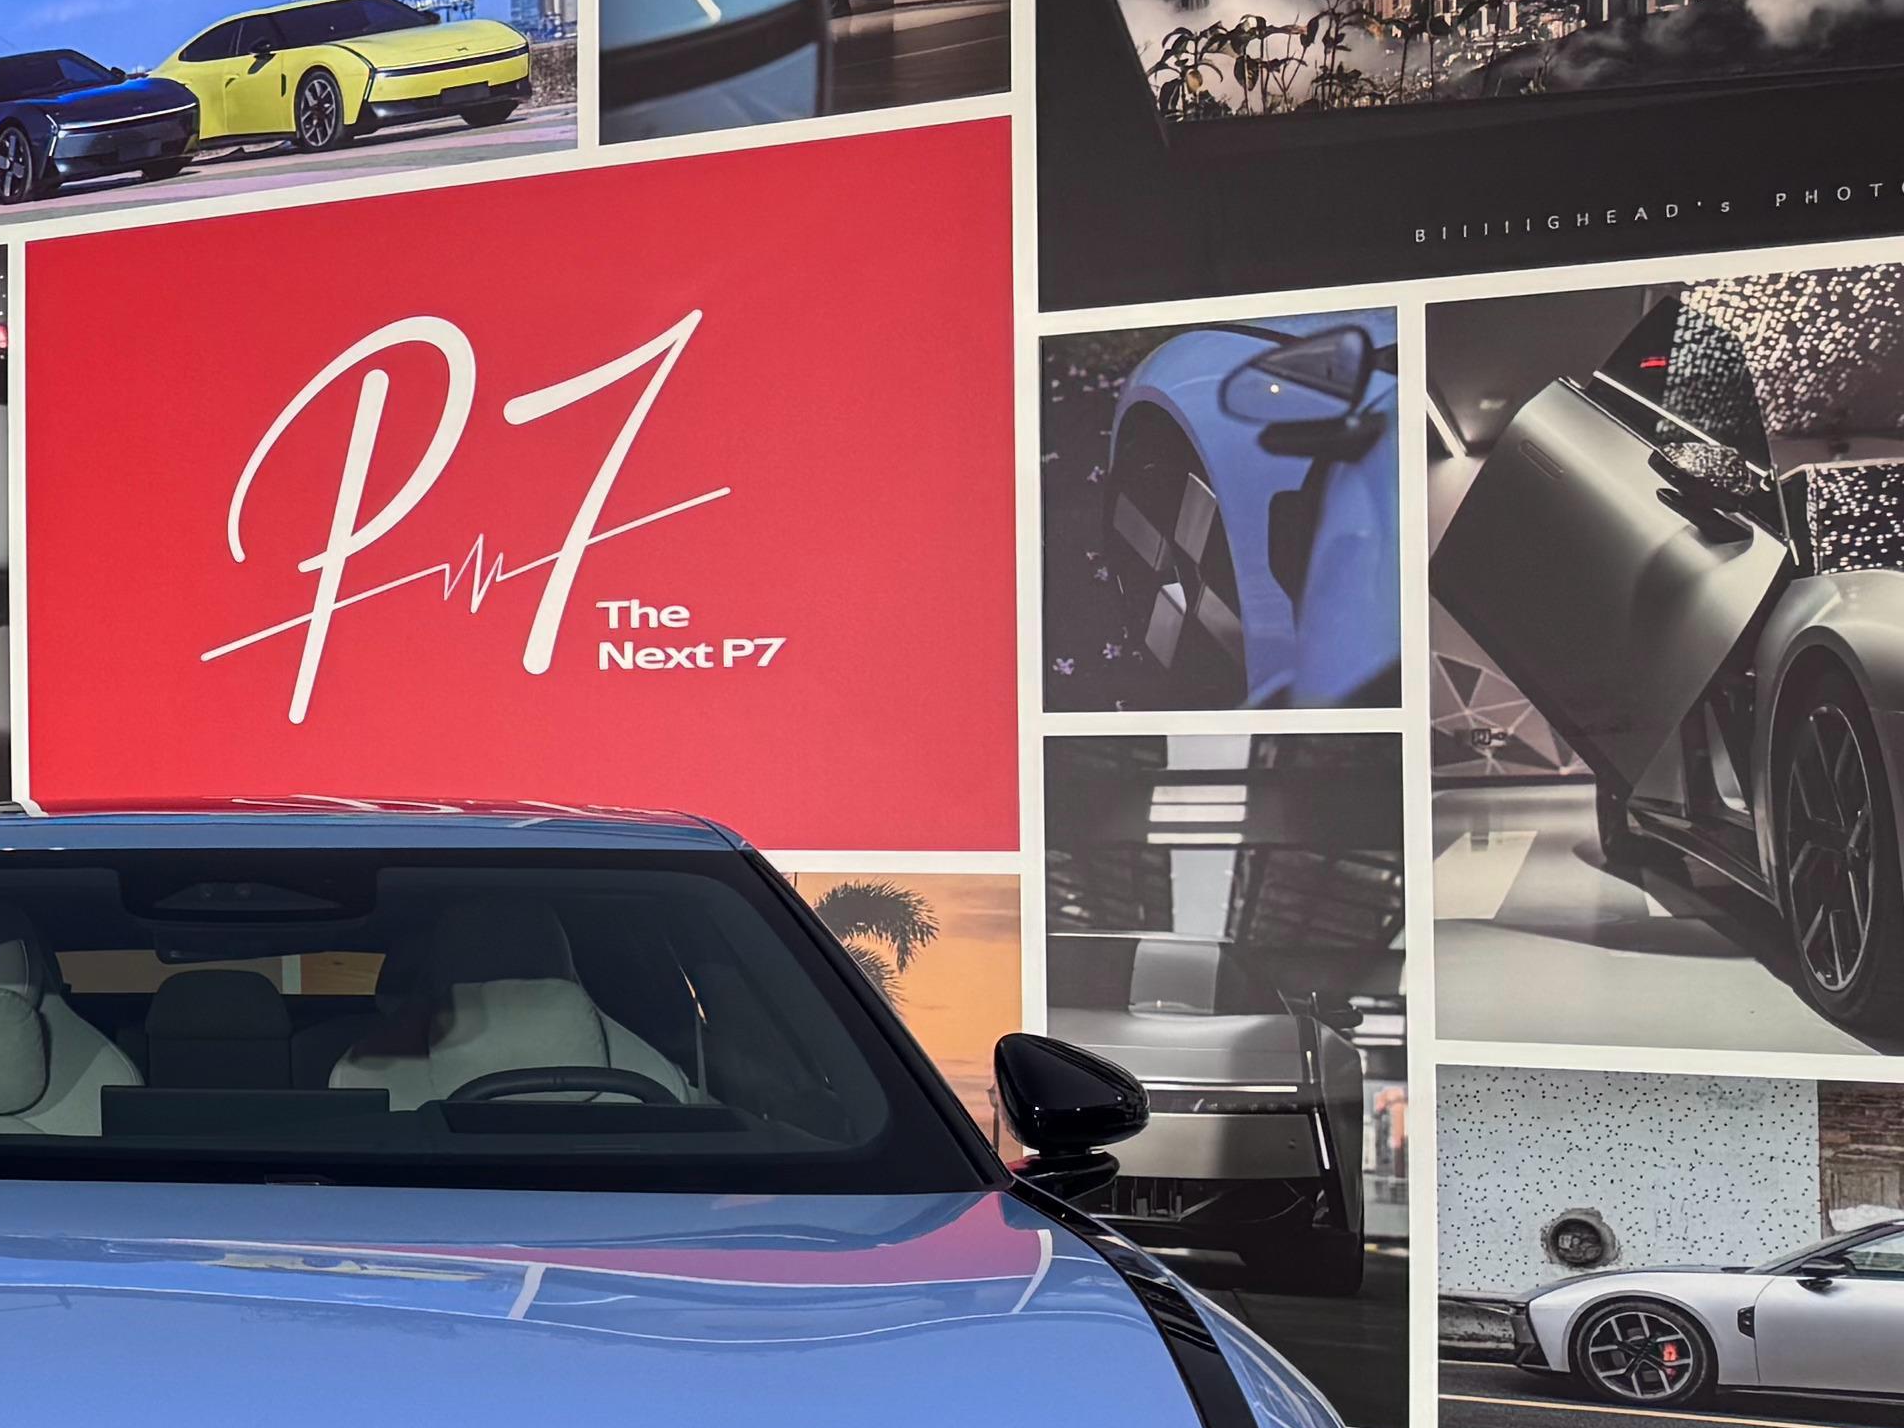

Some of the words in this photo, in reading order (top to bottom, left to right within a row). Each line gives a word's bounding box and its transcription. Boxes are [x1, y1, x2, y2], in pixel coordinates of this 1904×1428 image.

[1775, 182, 1904, 208] PHOT
[595, 599, 691, 629] The
[598, 641, 714, 671] Next
[722, 637, 787, 668] P7
